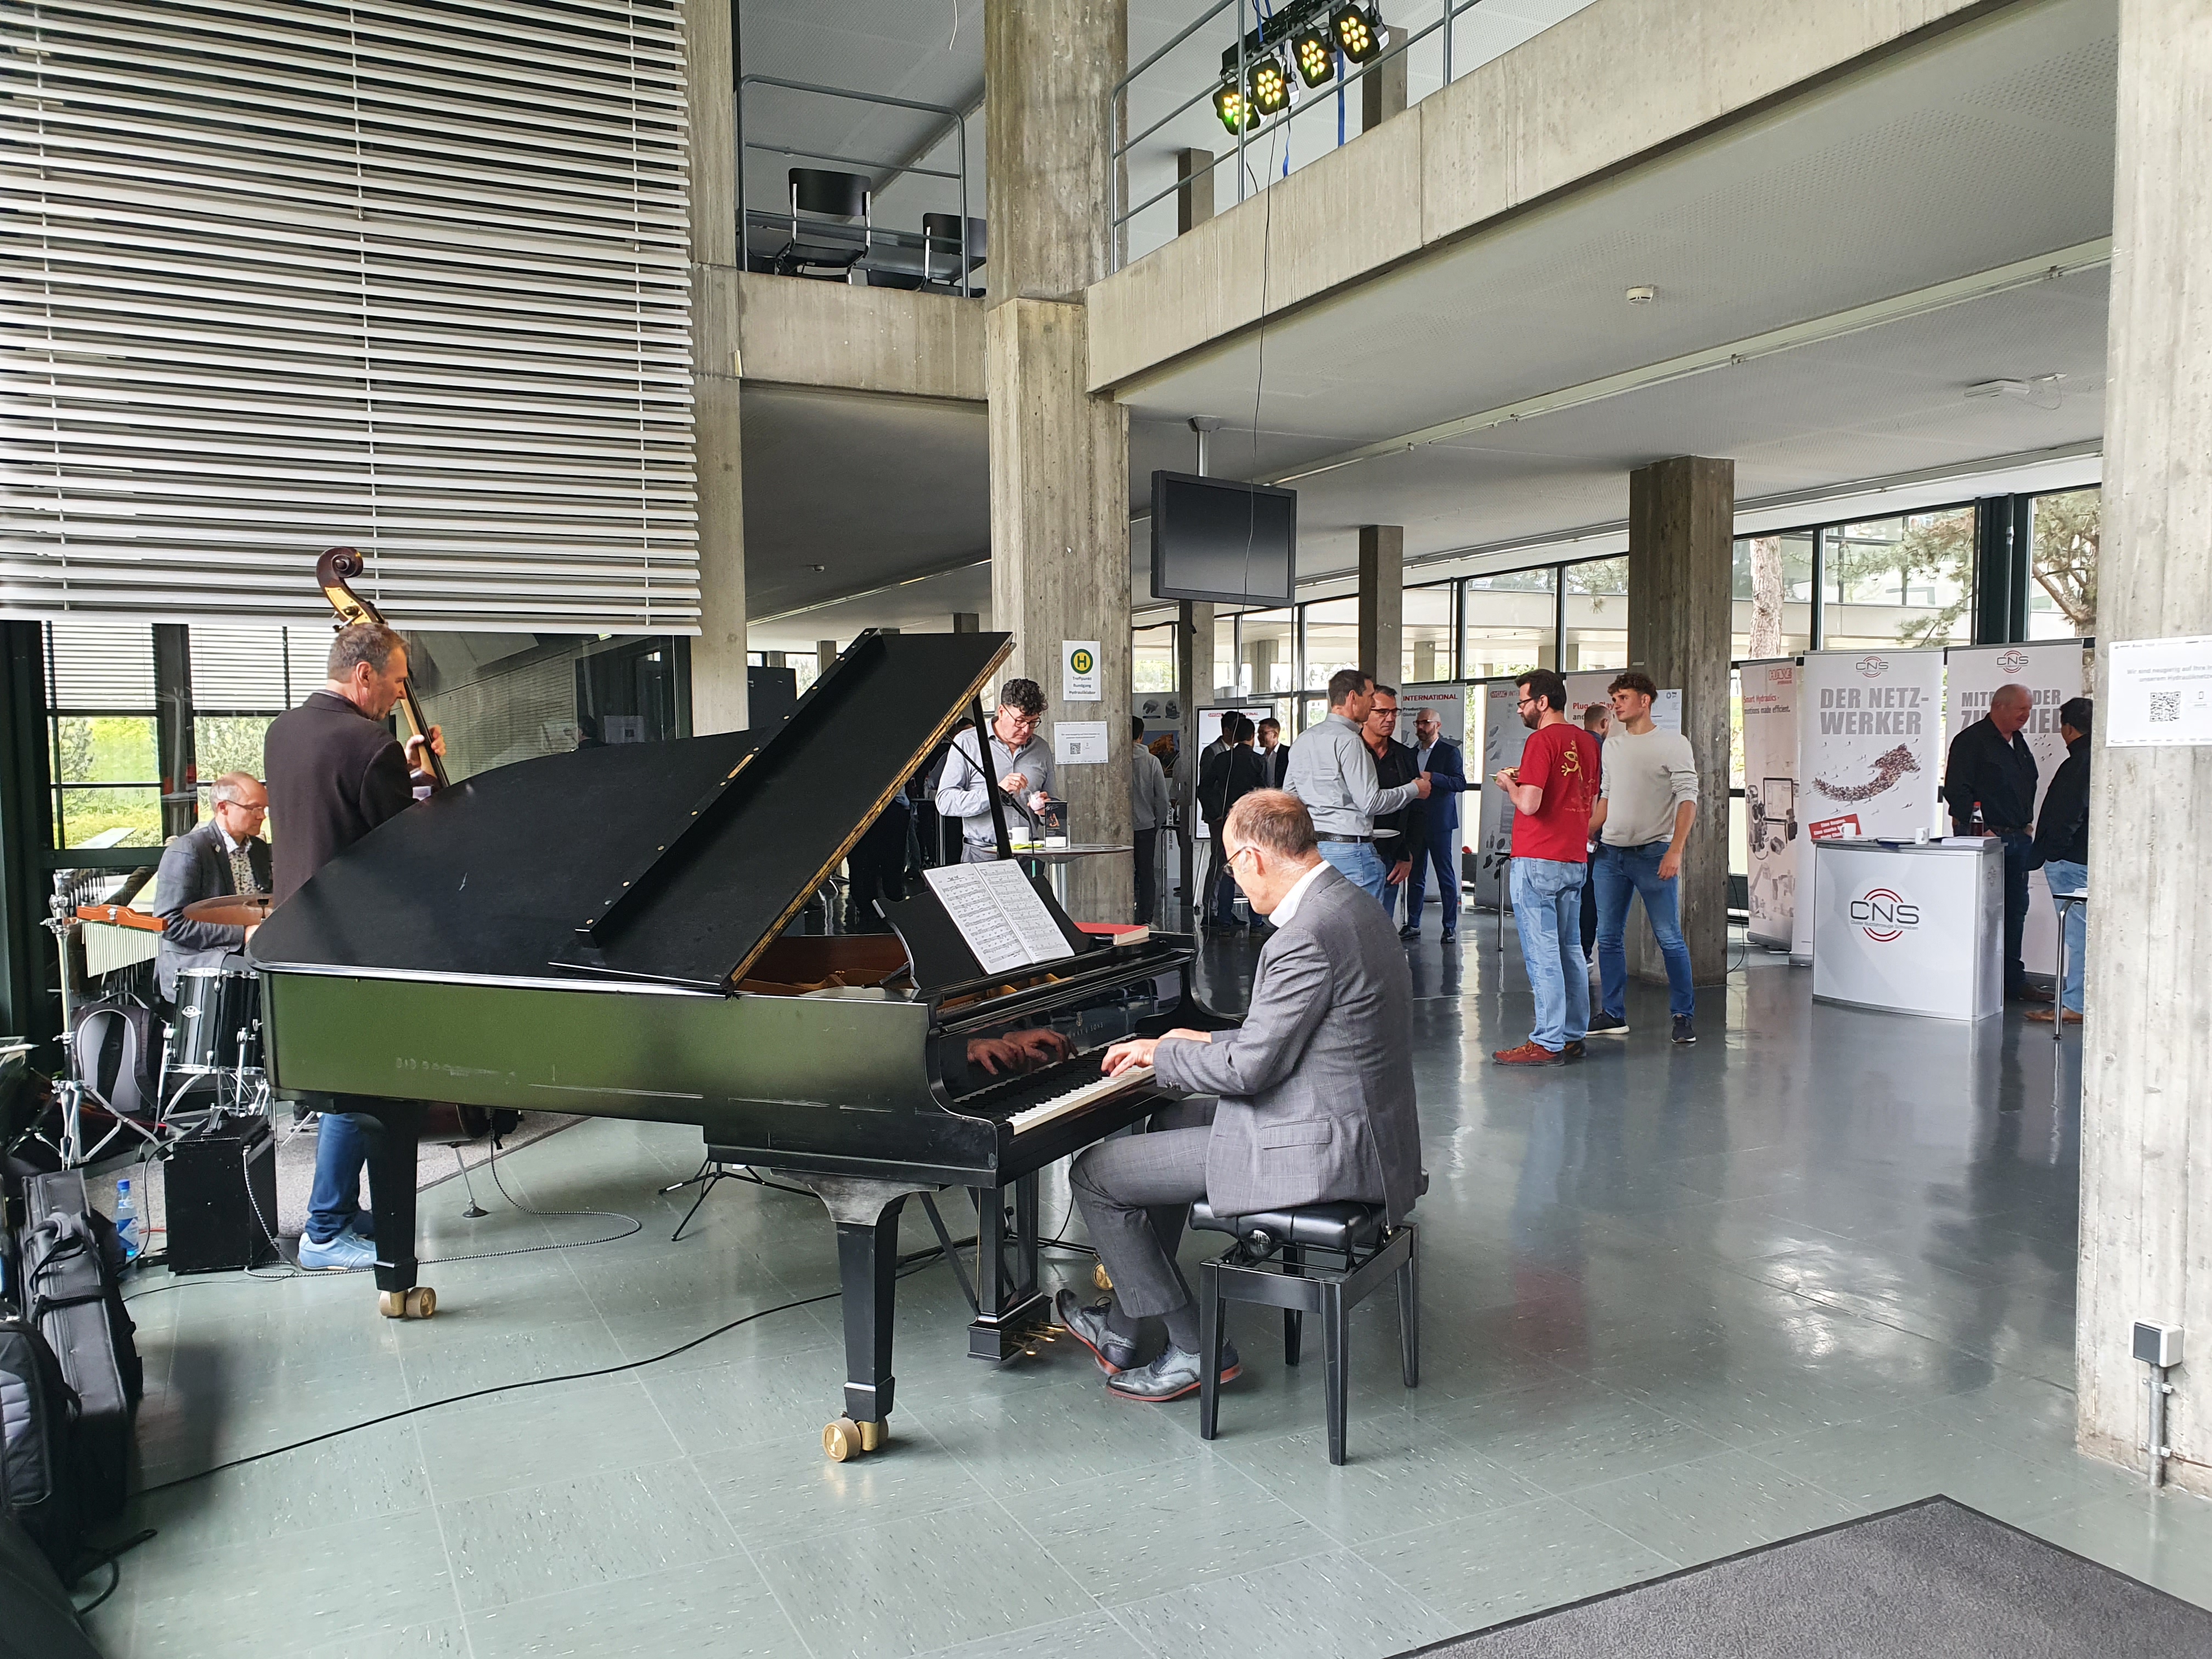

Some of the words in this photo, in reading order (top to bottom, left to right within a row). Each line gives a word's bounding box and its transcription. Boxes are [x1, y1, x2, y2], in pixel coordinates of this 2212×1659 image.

[1077, 655, 1086, 668] H
[1855, 661, 1889, 670] CNS
[1996, 656, 2029, 665] CNS
[1820, 688, 1861, 708] DER
[1869, 687, 1929, 708] NETZ-
[1820, 712, 1921, 735] WERKER
[1850, 900, 1920, 924] CNS
